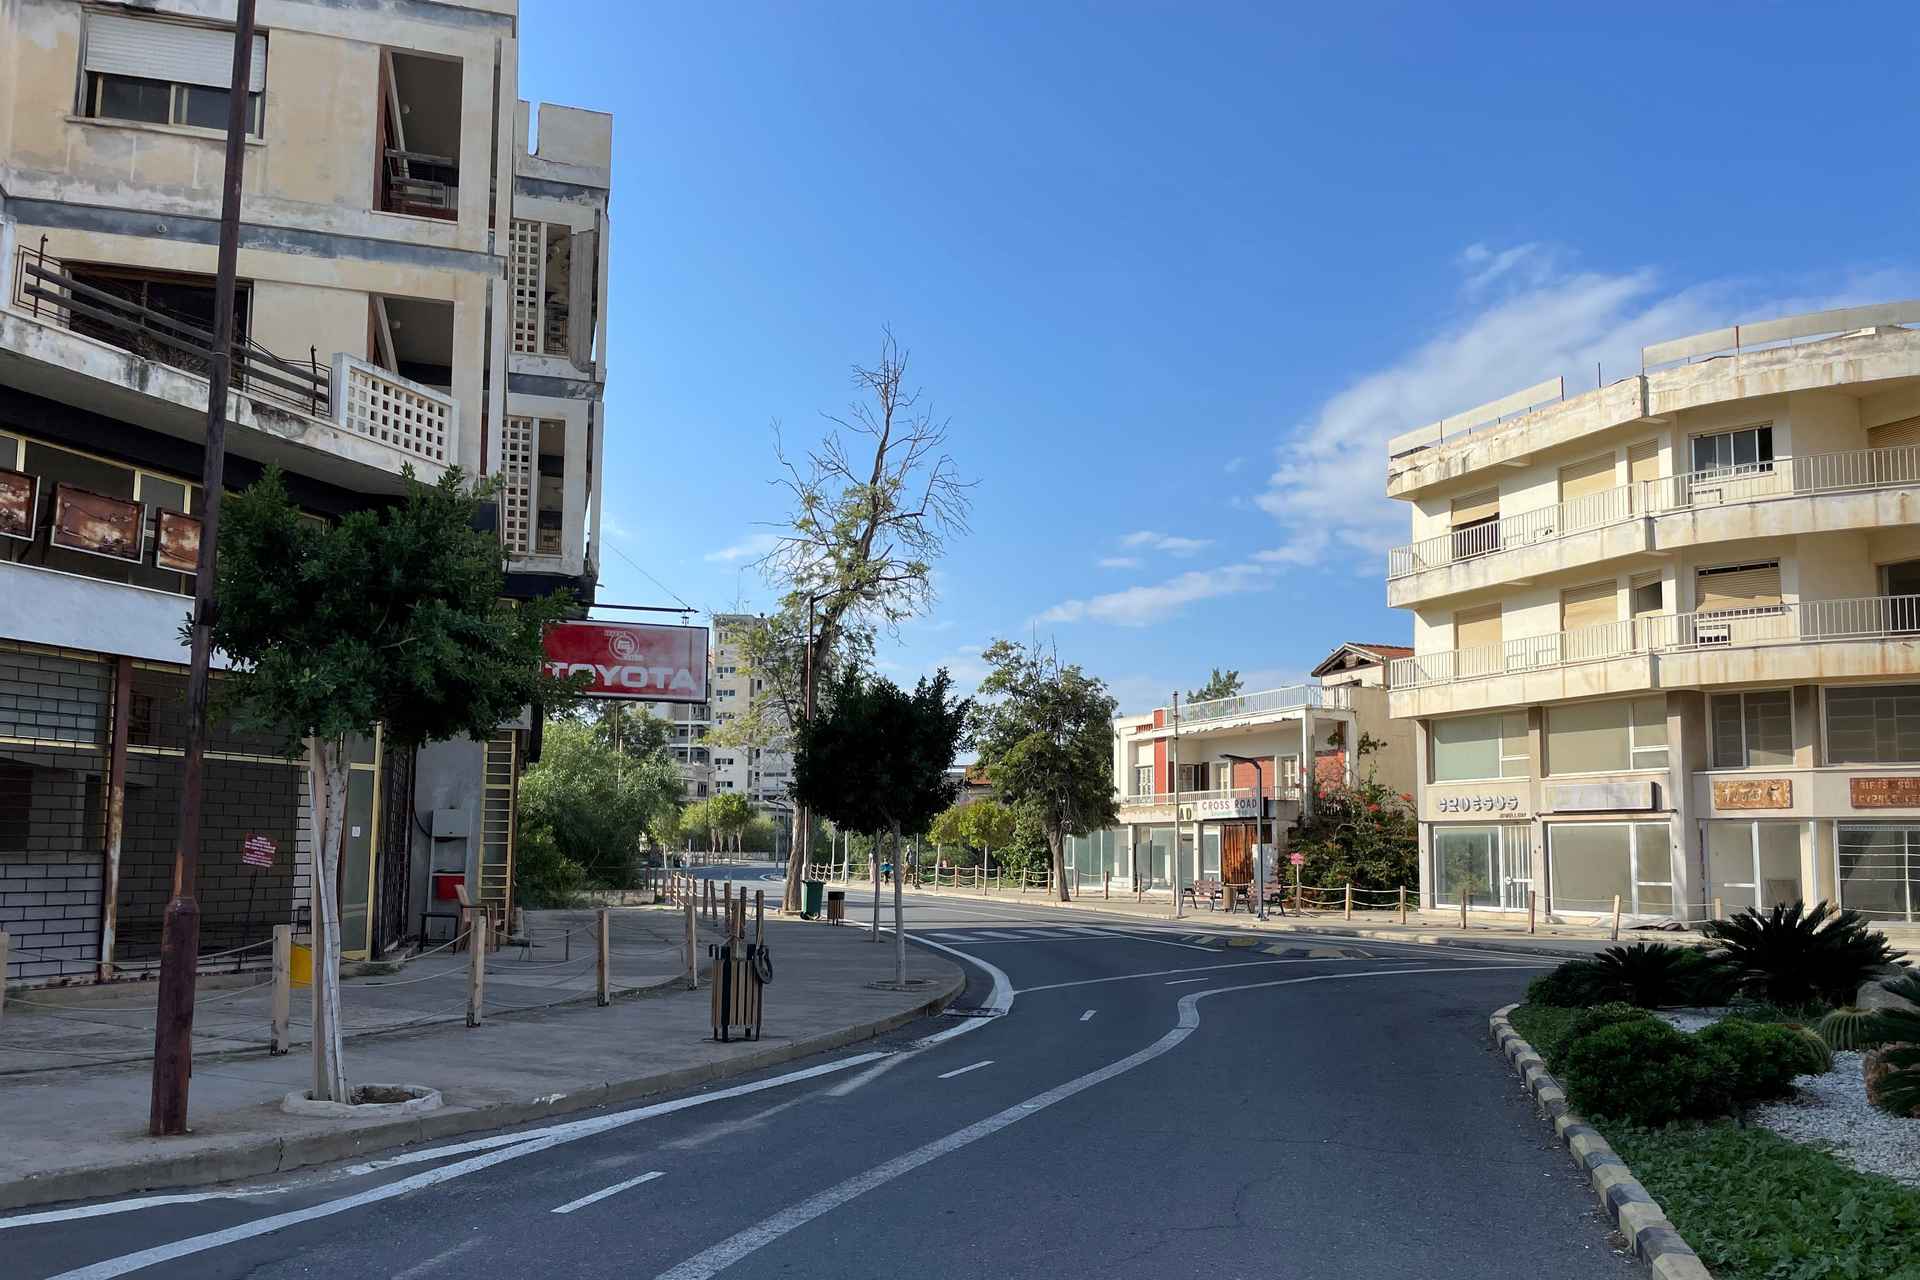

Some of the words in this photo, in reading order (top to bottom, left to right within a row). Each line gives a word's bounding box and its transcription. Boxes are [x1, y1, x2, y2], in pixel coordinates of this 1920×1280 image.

[545, 662, 697, 690] TOYOTA
[1202, 800, 1230, 810] CROSS
[1234, 799, 1257, 809] ROAD
